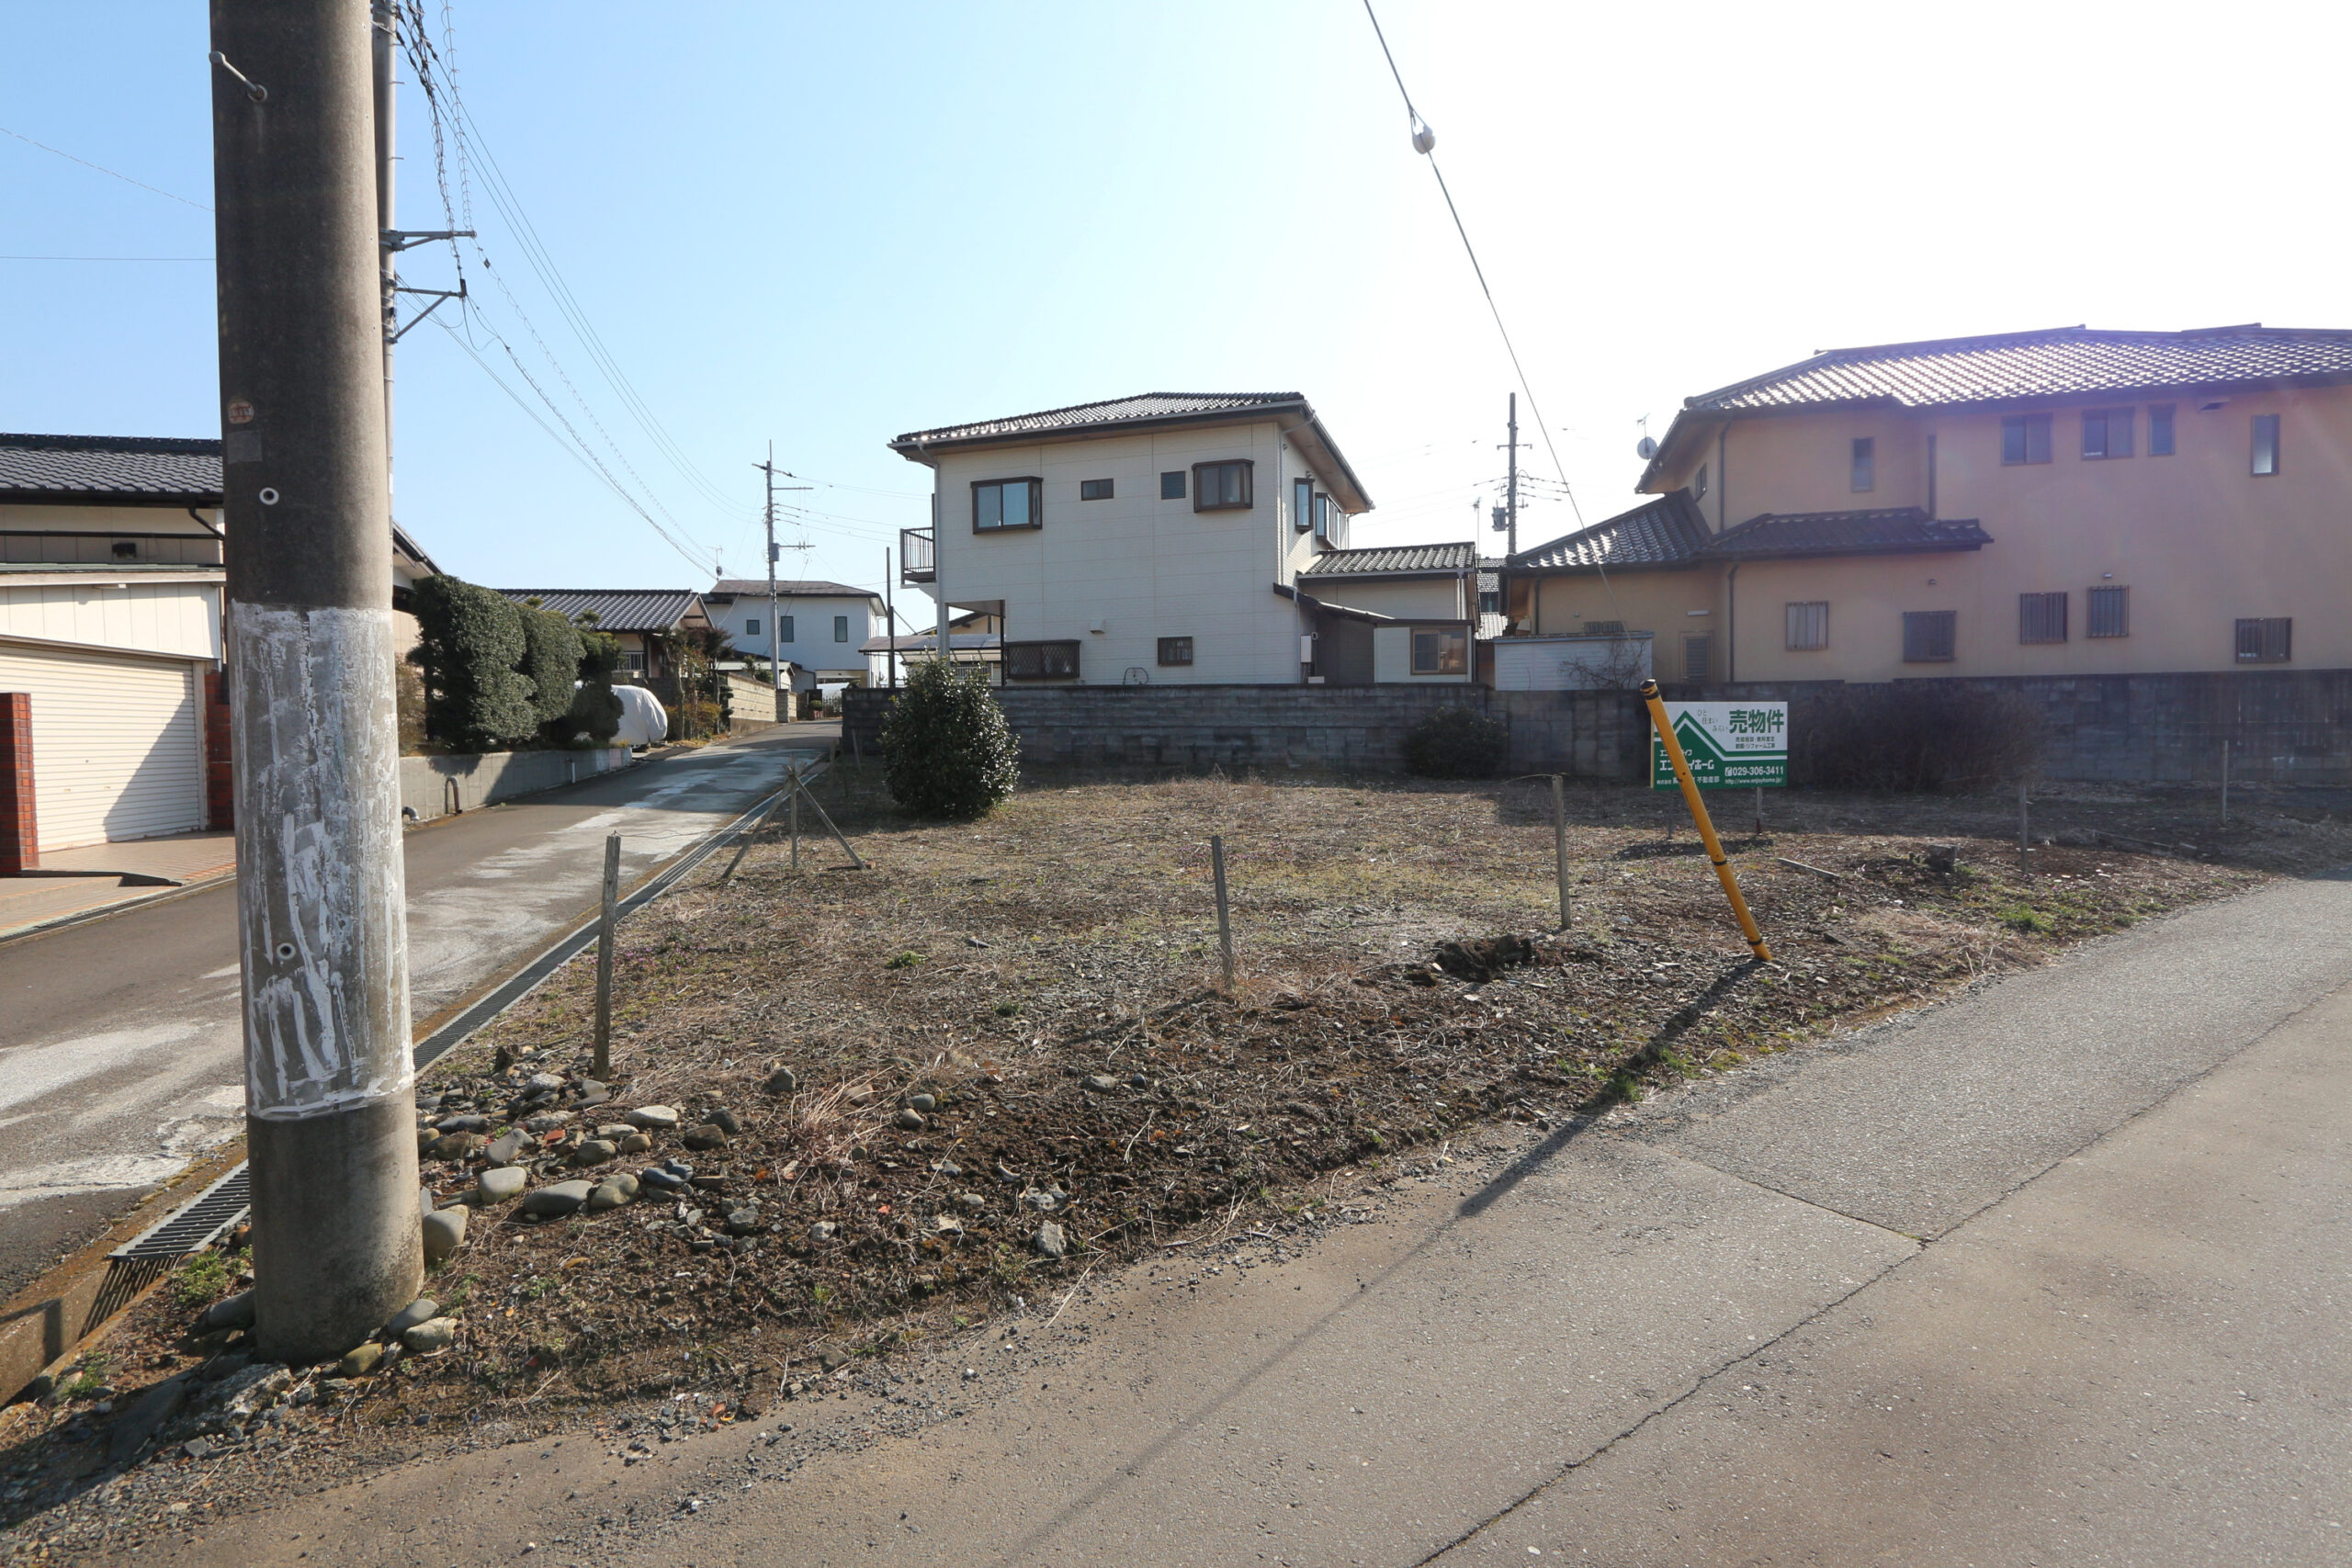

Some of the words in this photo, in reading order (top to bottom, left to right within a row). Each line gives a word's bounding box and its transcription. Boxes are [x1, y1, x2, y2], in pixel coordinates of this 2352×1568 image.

[1729, 709, 1784, 734] 売物件
[1733, 766, 1783, 775] 029-306-3411
